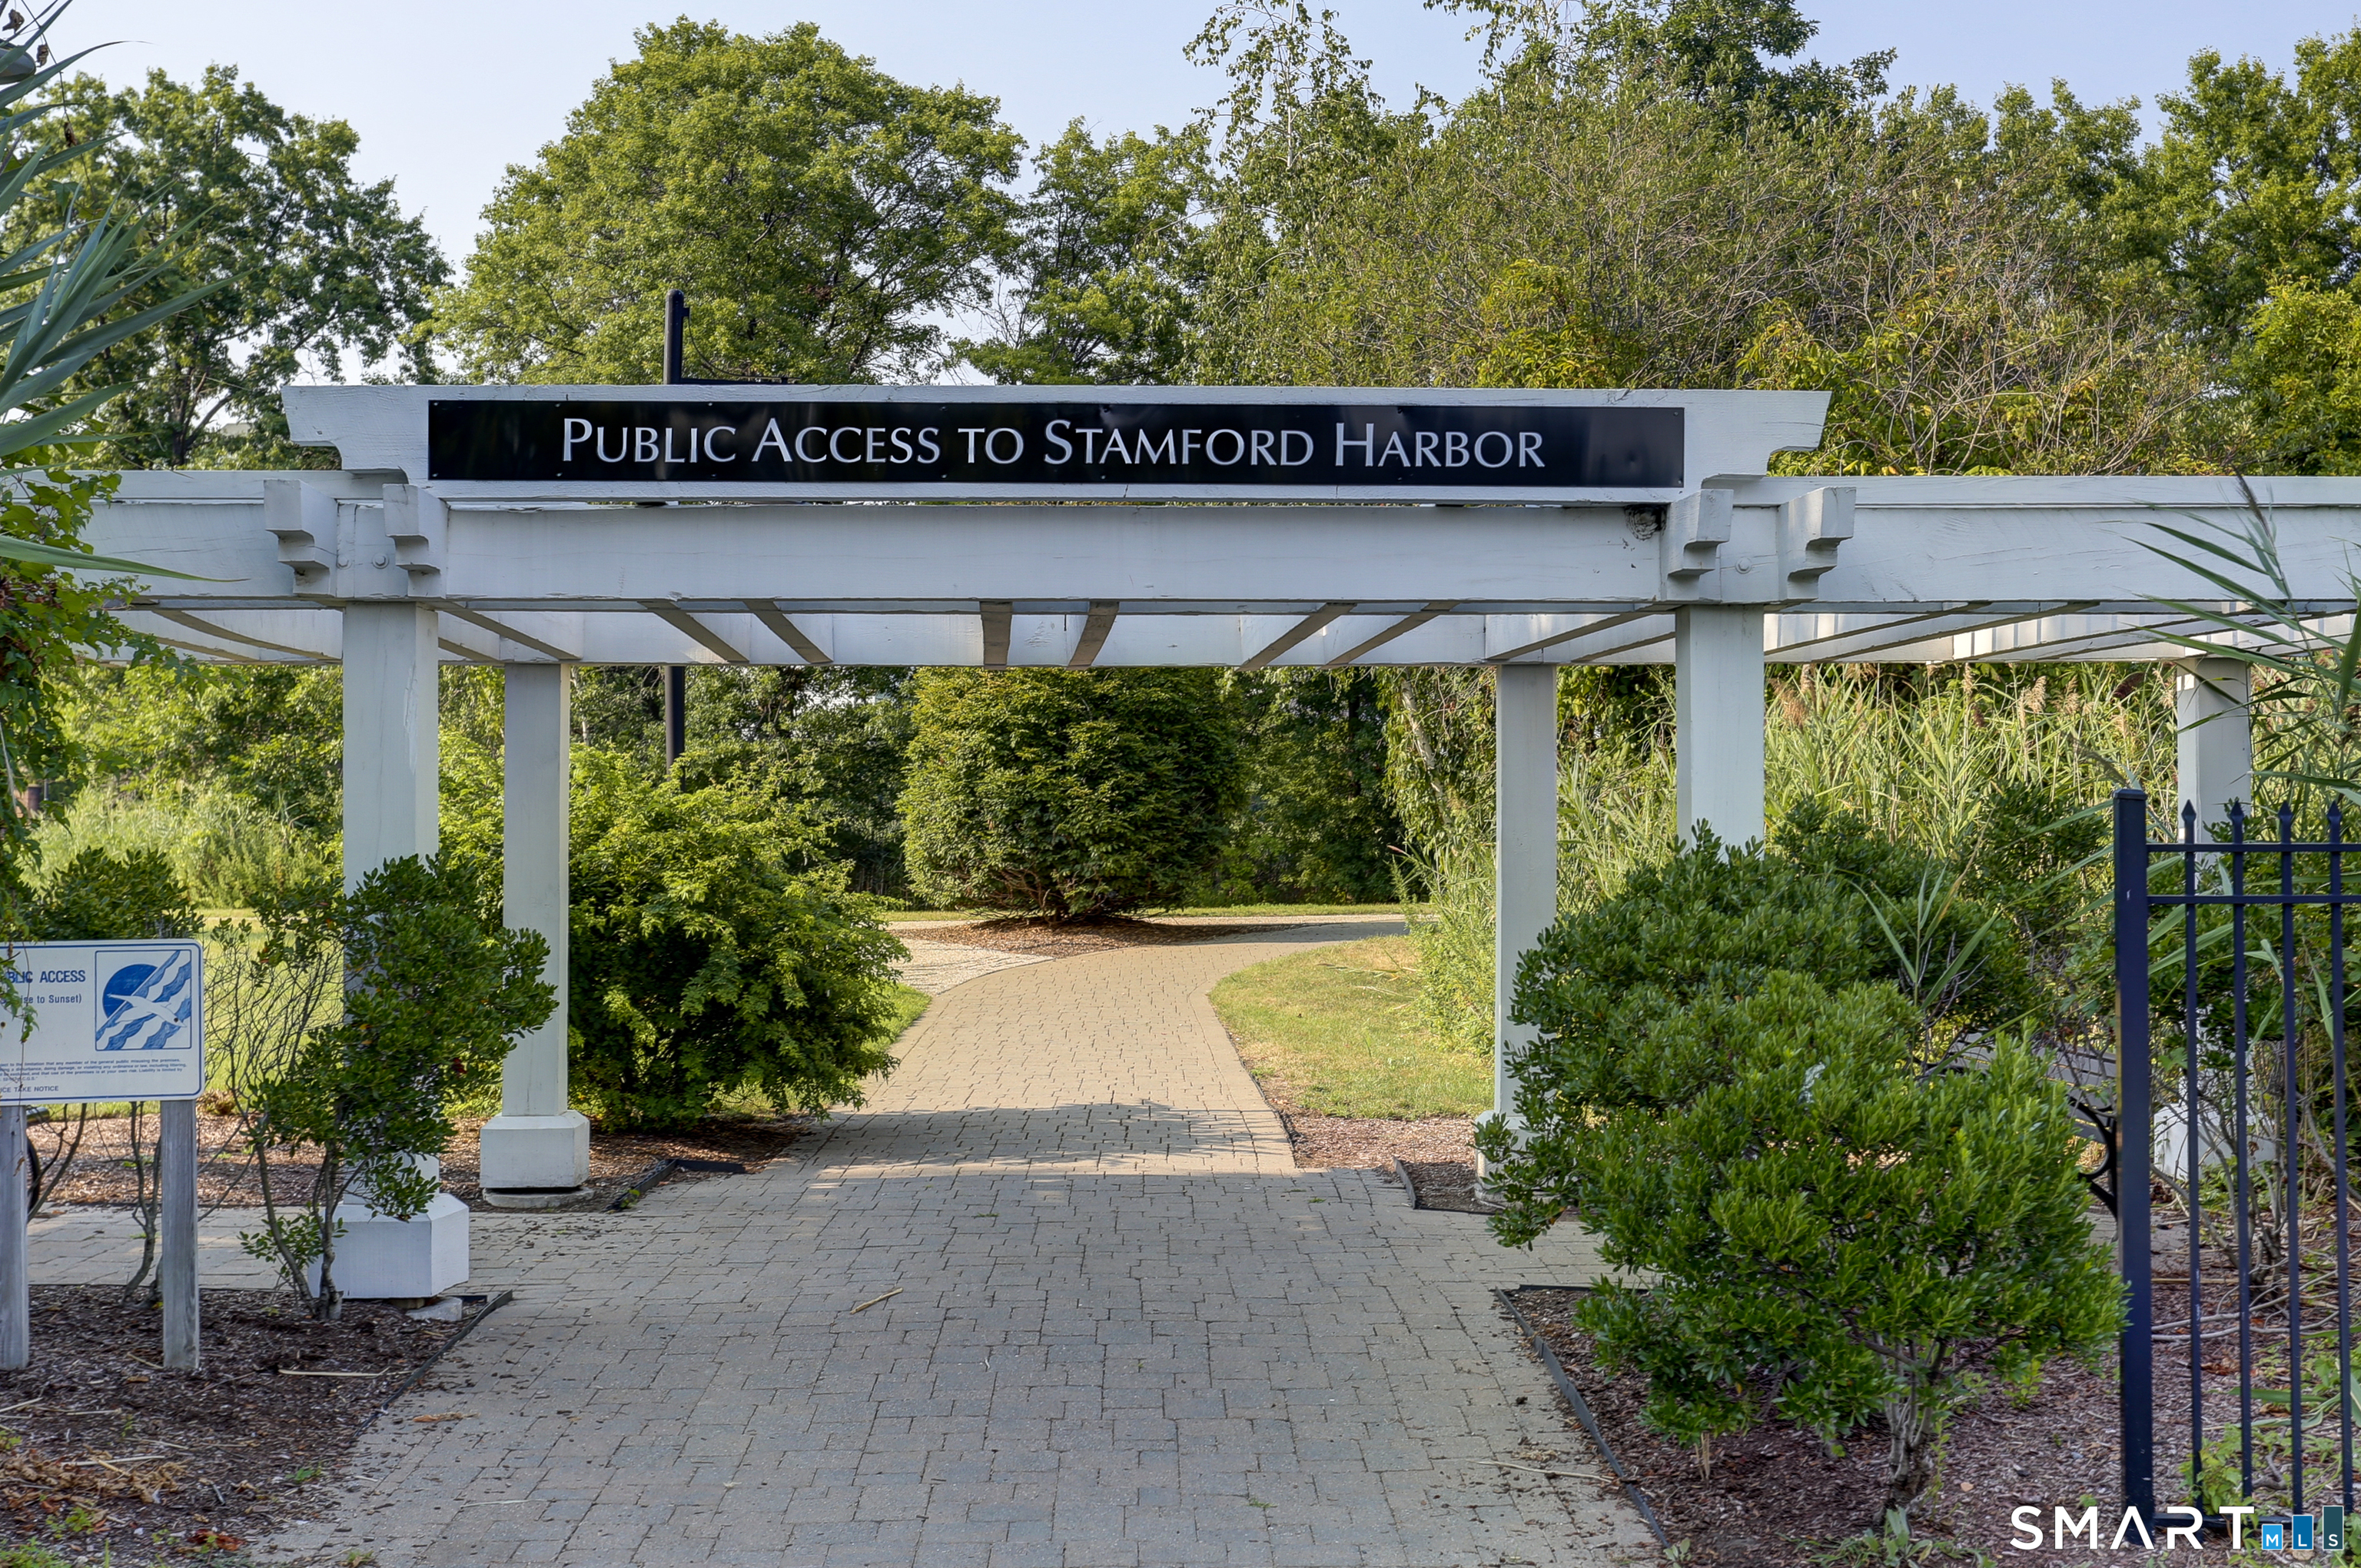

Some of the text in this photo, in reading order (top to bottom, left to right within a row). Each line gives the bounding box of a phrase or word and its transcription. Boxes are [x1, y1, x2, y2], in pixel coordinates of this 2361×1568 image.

[563, 417, 1546, 468] PUBLIC ACCESS TO STAMFORD HARBOR
[6, 970, 86, 983] BLIC ACCESS
[37, 995, 45, 1004] to
[48, 993, 82, 1004] Sunset)
